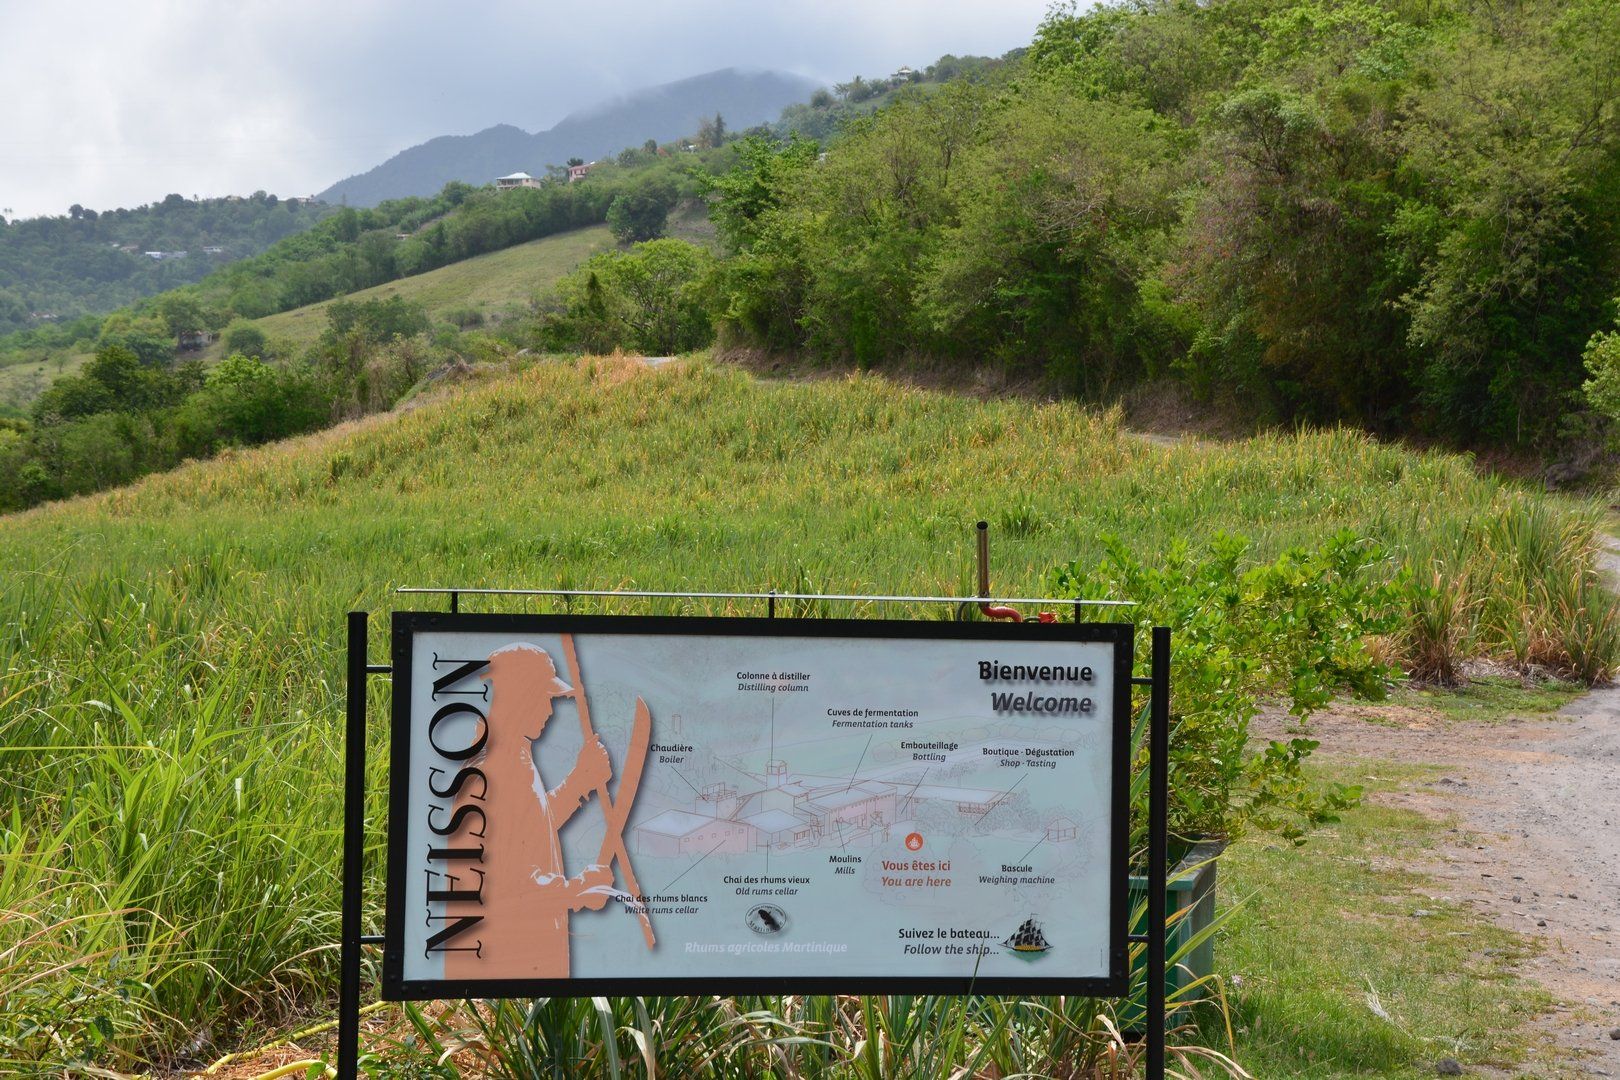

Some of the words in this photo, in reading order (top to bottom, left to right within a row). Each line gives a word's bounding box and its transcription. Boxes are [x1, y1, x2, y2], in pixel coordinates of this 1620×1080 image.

[978, 660, 1093, 681] Bienvenue
[736, 671, 770, 681] Colonne
[771, 671, 777, 681] à
[778, 671, 811, 681] distiller
[737, 683, 776, 693] Distilling
[778, 683, 809, 692] column
[991, 691, 1093, 713] Welcome
[827, 708, 851, 717] Cuves
[852, 708, 864, 717] de
[864, 708, 919, 719] fermentation
[832, 719, 888, 729] Fermentation
[890, 719, 914, 729] tanks
[650, 744, 693, 753] Chaudière
[900, 741, 959, 751] Embouteillage
[912, 752, 947, 763] Bottling
[982, 747, 1019, 757] Boutique
[1025, 747, 1075, 758] Dégustation
[659, 755, 685, 764] Boiler
[1000, 758, 1020, 769] Shop
[1026, 758, 1057, 769] Tasting
[424, 651, 491, 960] NEISSON
[829, 855, 862, 863] Moulins
[834, 866, 856, 875] Mills
[881, 860, 909, 871] Vous
[911, 860, 936, 871] êtes
[938, 860, 951, 871] ici
[1001, 864, 1033, 873] Bascule
[723, 875, 742, 884] Chai
[743, 875, 759, 884] des
[760, 875, 787, 884] rhums
[788, 875, 810, 884] vieux
[881, 876, 902, 887] You
[904, 877, 924, 887] are
[926, 876, 951, 887] here
[979, 875, 1018, 885] Weighing
[1019, 875, 1055, 885] machine
[735, 887, 750, 896] Old
[751, 888, 773, 896] rums
[774, 887, 799, 896] cellar
[615, 894, 634, 903] Chai
[636, 894, 651, 903] des
[652, 894, 679, 903] rhums
[680, 894, 708, 903] blancs
[624, 905, 650, 915] White
[651, 907, 674, 915] rums
[675, 905, 699, 915] cellar
[898, 928, 935, 939] Suivez
[937, 928, 947, 939] le
[950, 928, 1000, 939] bateau...
[685, 942, 726, 954] Rhums
[727, 941, 780, 956] agricoles
[782, 942, 848, 956] Martinique
[903, 944, 942, 955] Follow
[944, 944, 964, 955] the
